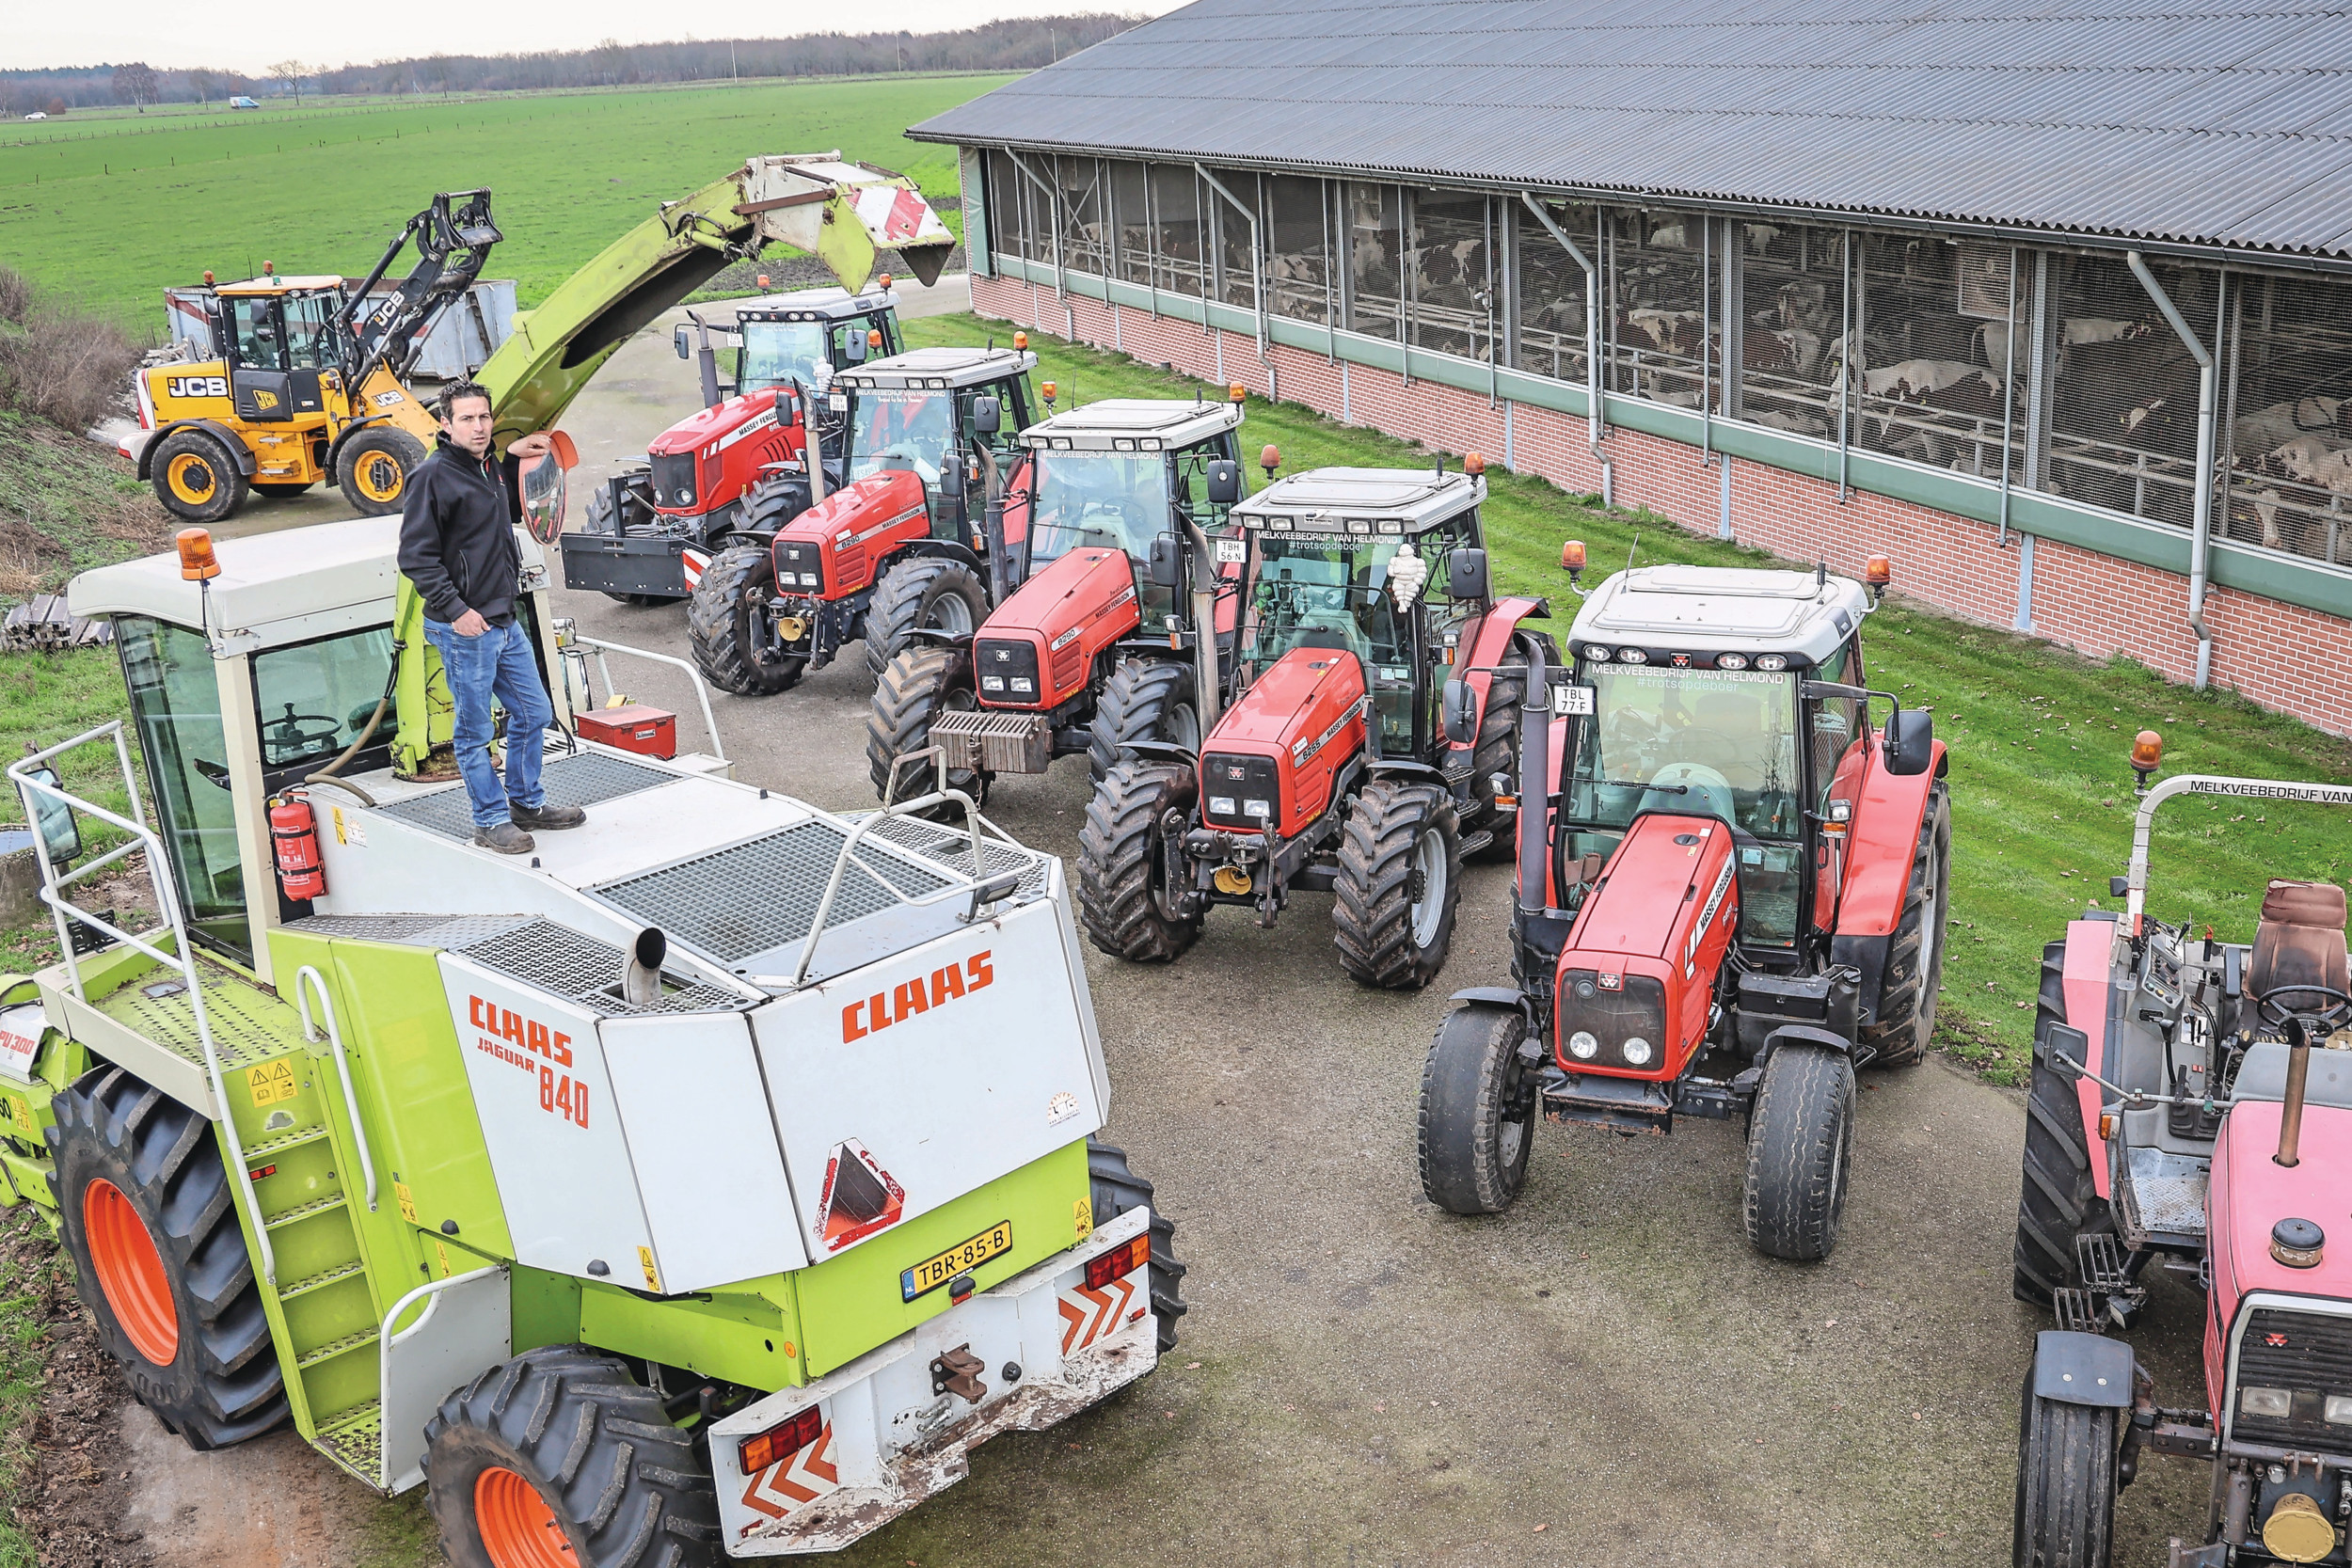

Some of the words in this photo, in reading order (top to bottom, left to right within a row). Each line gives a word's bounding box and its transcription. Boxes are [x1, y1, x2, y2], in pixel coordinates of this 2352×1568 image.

[376, 291, 405, 326] JCB
[169, 377, 228, 397] JCB
[258, 392, 278, 407] JCB
[376, 390, 405, 407] JCB
[739, 420, 759, 436] MASSEY
[759, 411, 777, 424] FERGU
[1042, 451, 1104, 459] MELKVEEBEDRIJF
[1122, 451, 1160, 460] HELMOND
[882, 518, 900, 529] MASSEY
[899, 507, 920, 522] FERGUSON
[1222, 542, 1240, 551] TBH
[1256, 531, 1331, 542] MELKVEEBEDRIJF
[1333, 533, 1352, 542] VAN
[1353, 534, 1398, 545] HELMOND
[1289, 541, 1364, 552] #trotsopdeboer
[1095, 605, 1111, 619] MASSEY
[1111, 592, 1130, 609] FERGUSON
[1057, 628, 1075, 646] 6290
[1592, 664, 1692, 679] MELKVEEBEDRIJF
[1695, 669, 1721, 680] VAN
[1724, 671, 1785, 685] HELMOND
[1636, 676, 1740, 692] #trotsopdeboer
[1563, 689, 1584, 700] TBL
[1326, 719, 1343, 738] MASSEY
[1343, 701, 1361, 724] FERGUSON
[2190, 781, 2318, 800] MELKVEEBEDRIJF
[2321, 790, 2352, 803] VAN
[1699, 895, 1716, 931] MASSEY
[1715, 862, 1733, 903] FERGUSON
[841, 949, 993, 1044] CLAAS
[469, 994, 573, 1069] CLAAS
[9, 1035, 36, 1055] 300
[477, 1037, 535, 1074] JAGUAR
[540, 1064, 589, 1130] 840
[918, 1229, 1005, 1286] TBR-85-B
[905, 1286, 914, 1294] NL
